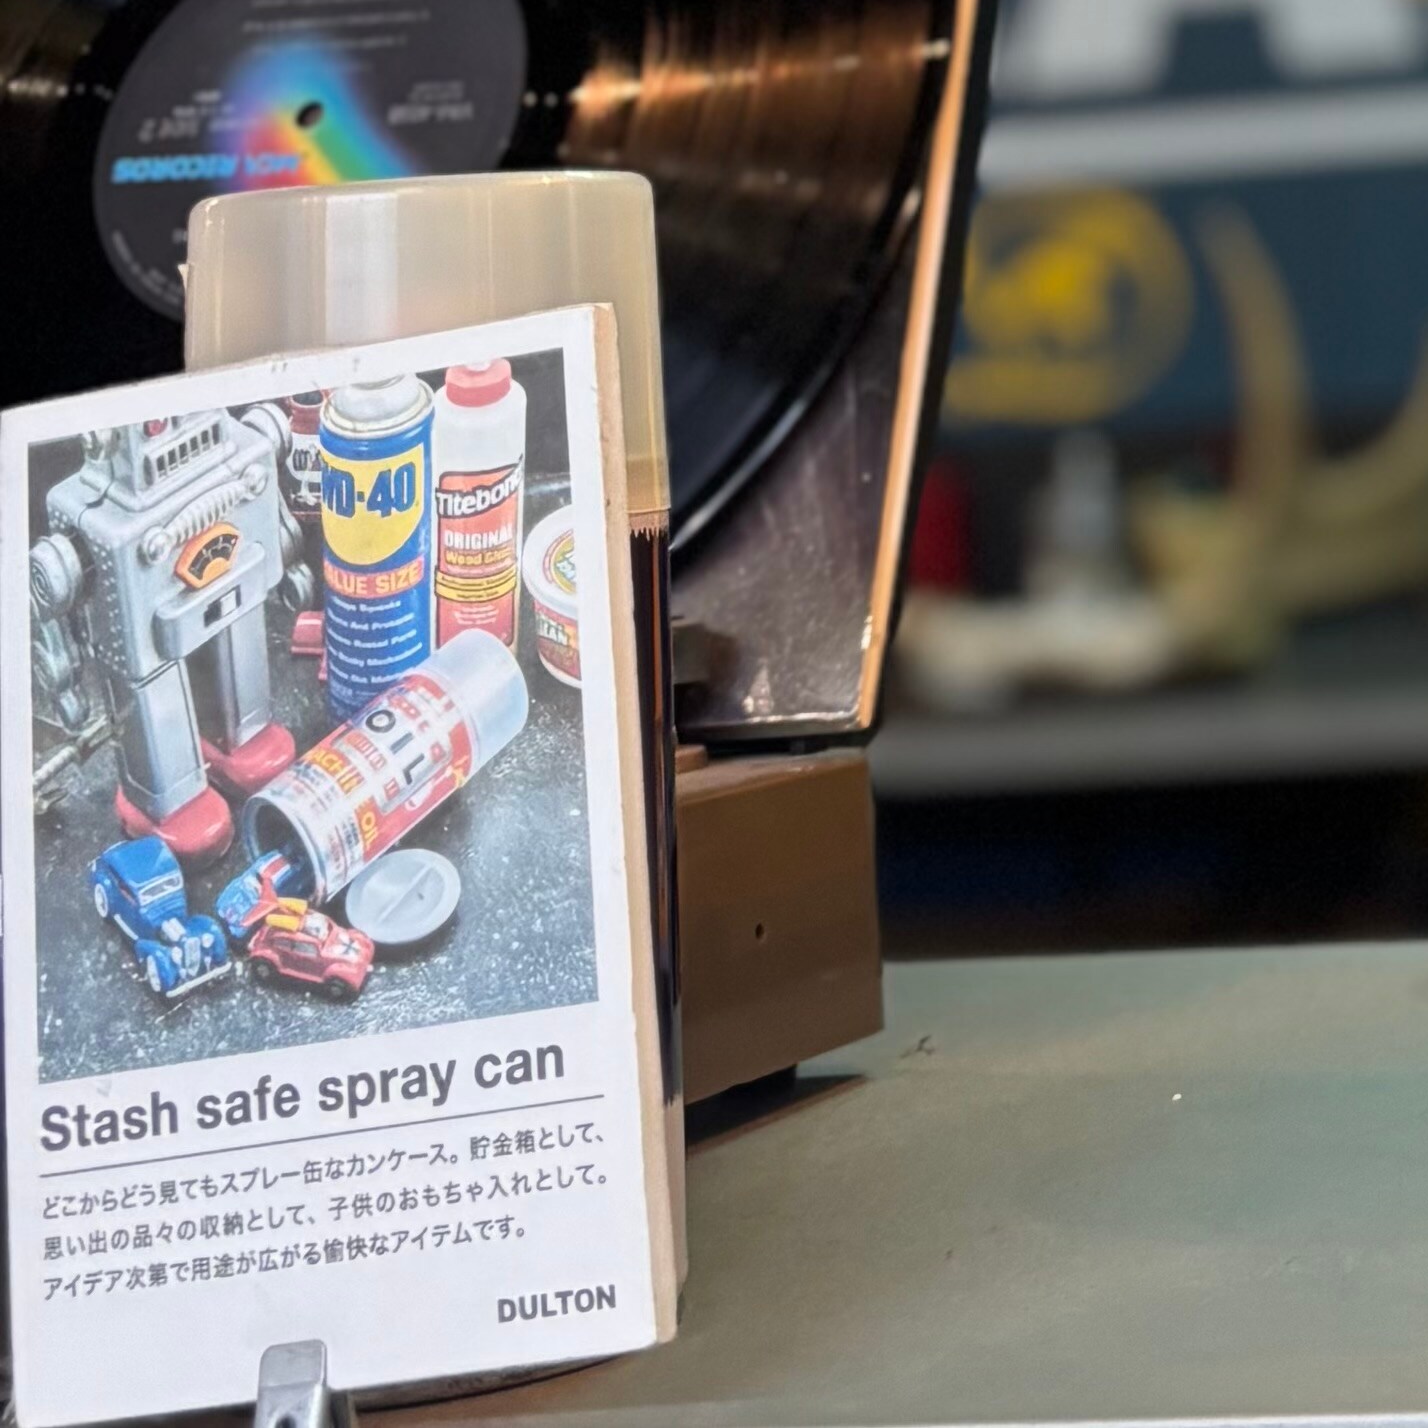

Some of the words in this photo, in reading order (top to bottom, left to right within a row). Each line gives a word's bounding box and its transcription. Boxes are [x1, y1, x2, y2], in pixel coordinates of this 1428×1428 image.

[375, 562, 420, 594] SIZE
[365, 708, 426, 785] OIL
[39, 1090, 179, 1152] Stash
[196, 1074, 301, 1130] safe
[317, 1059, 457, 1119] spray
[474, 1044, 565, 1089] can
[496, 1283, 617, 1324] DULTON
